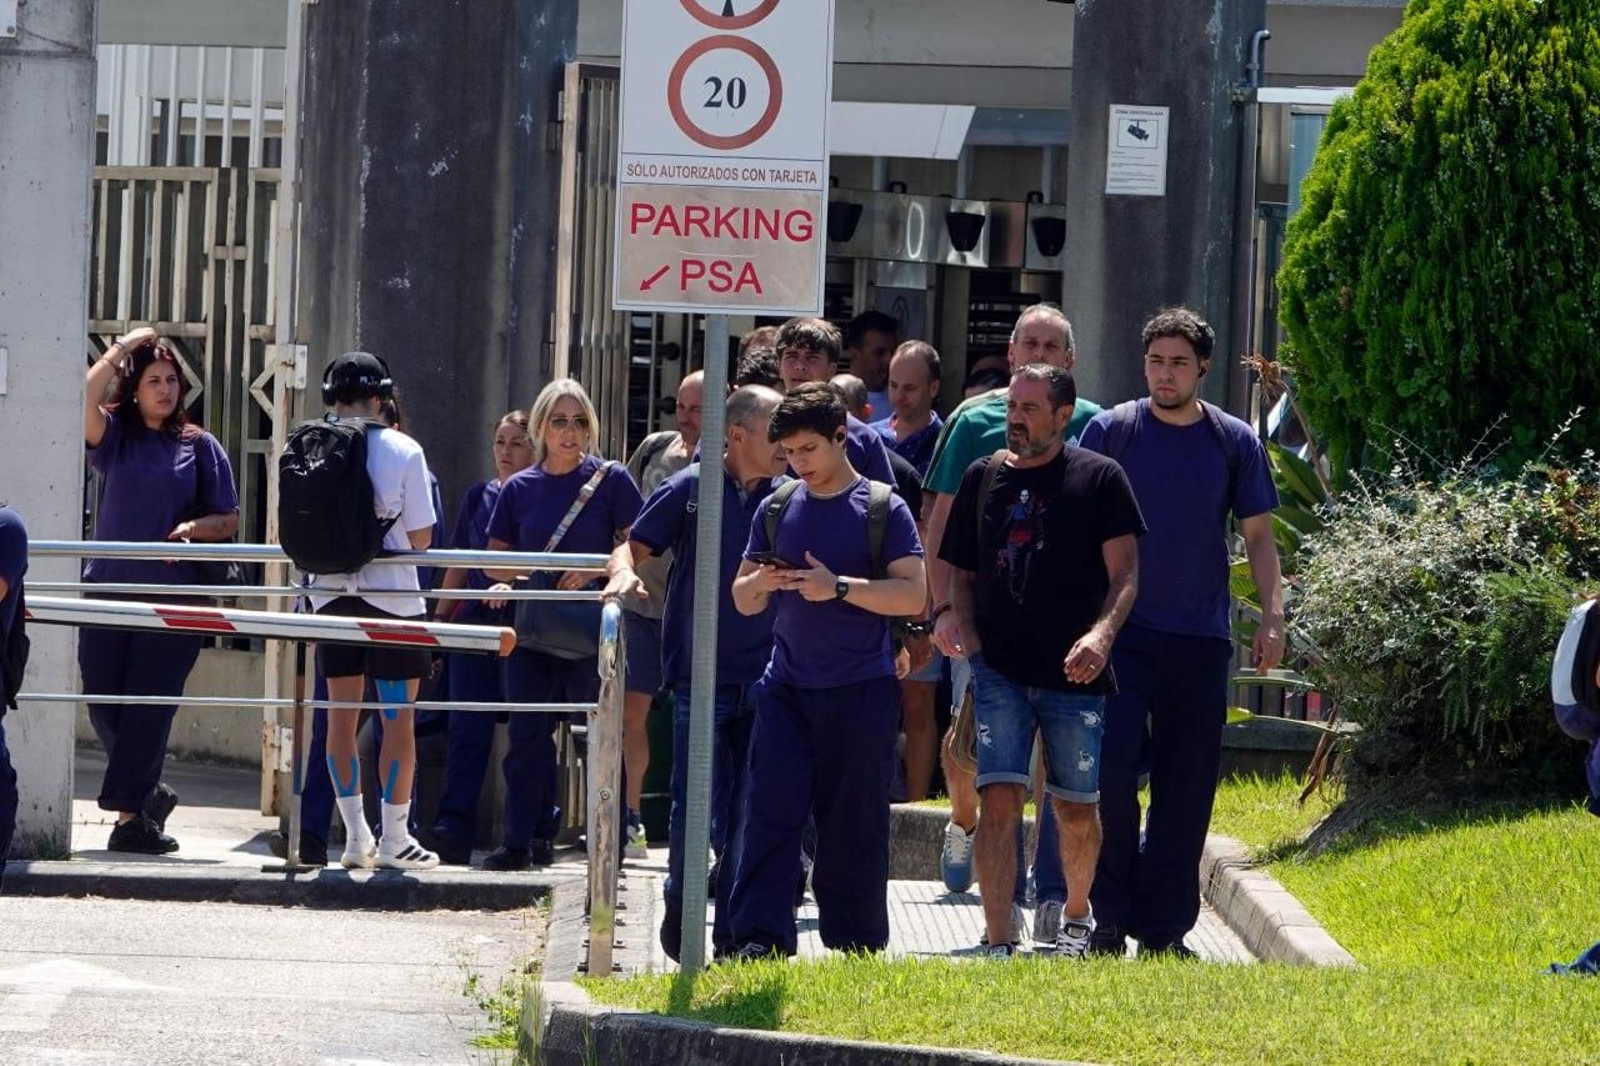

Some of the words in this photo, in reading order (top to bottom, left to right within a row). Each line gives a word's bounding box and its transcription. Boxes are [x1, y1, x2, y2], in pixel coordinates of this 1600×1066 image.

[703, 76, 747, 109] 20
[627, 161, 657, 177] SÓLO
[660, 165, 738, 181] AUTORIZADOS
[742, 168, 766, 182] CON
[769, 169, 817, 183] TARJETA
[630, 203, 813, 242] PARKING
[680, 259, 763, 294] PSA
